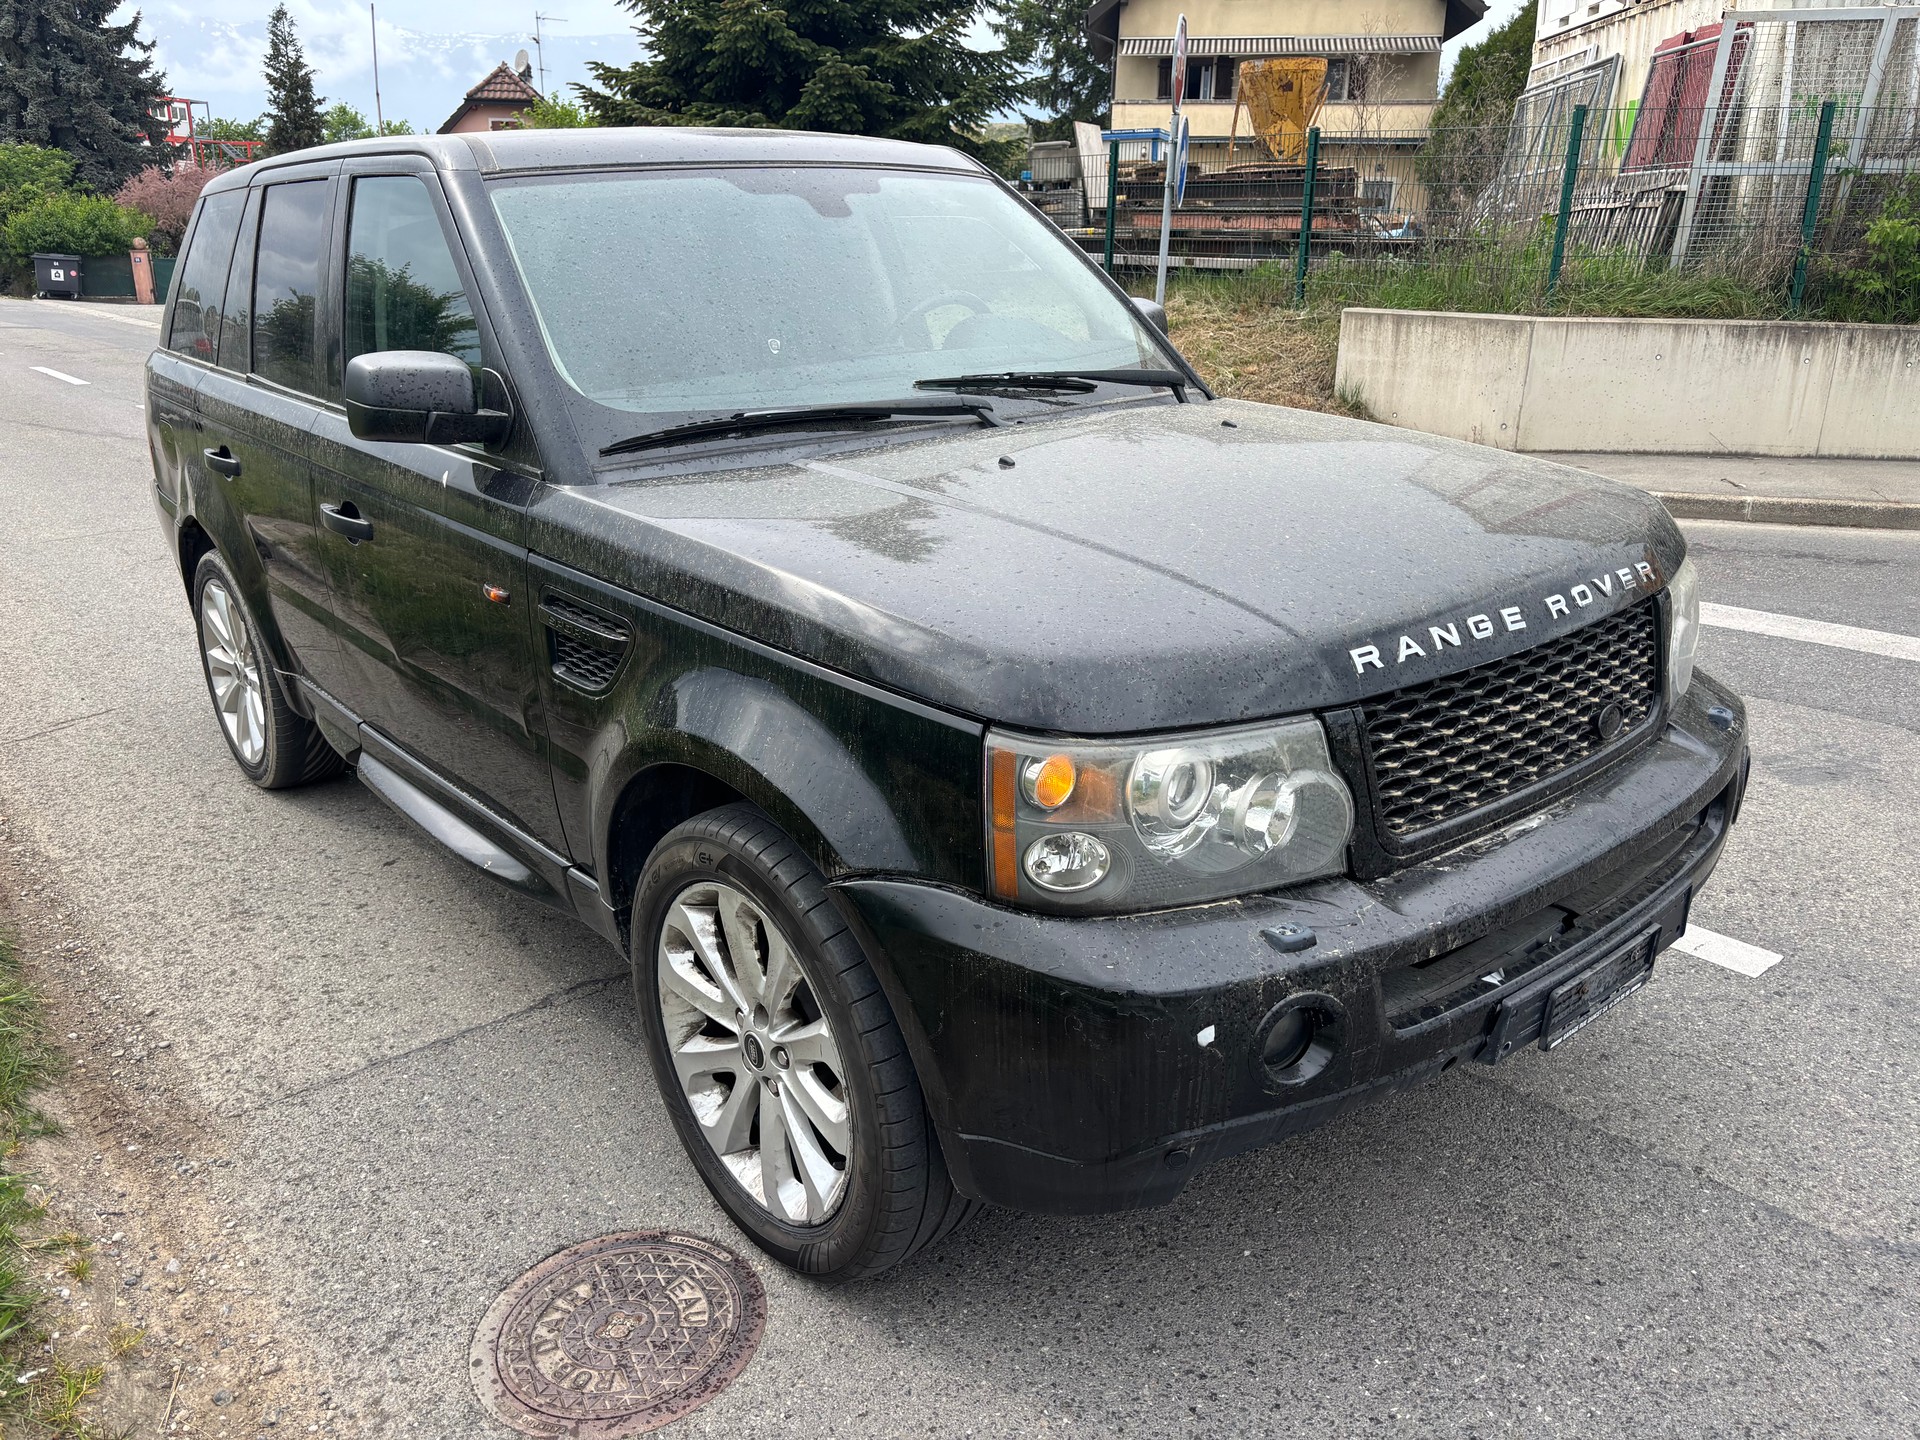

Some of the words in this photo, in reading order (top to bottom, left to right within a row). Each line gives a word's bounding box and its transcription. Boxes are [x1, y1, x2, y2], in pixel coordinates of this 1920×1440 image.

[548, 615, 590, 640] SPORT
[1350, 606, 1527, 674] RANGE
[1545, 560, 1656, 619] ROVER
[667, 1236, 717, 1254] CAMPONOVO
[670, 1279, 708, 1323] EAU
